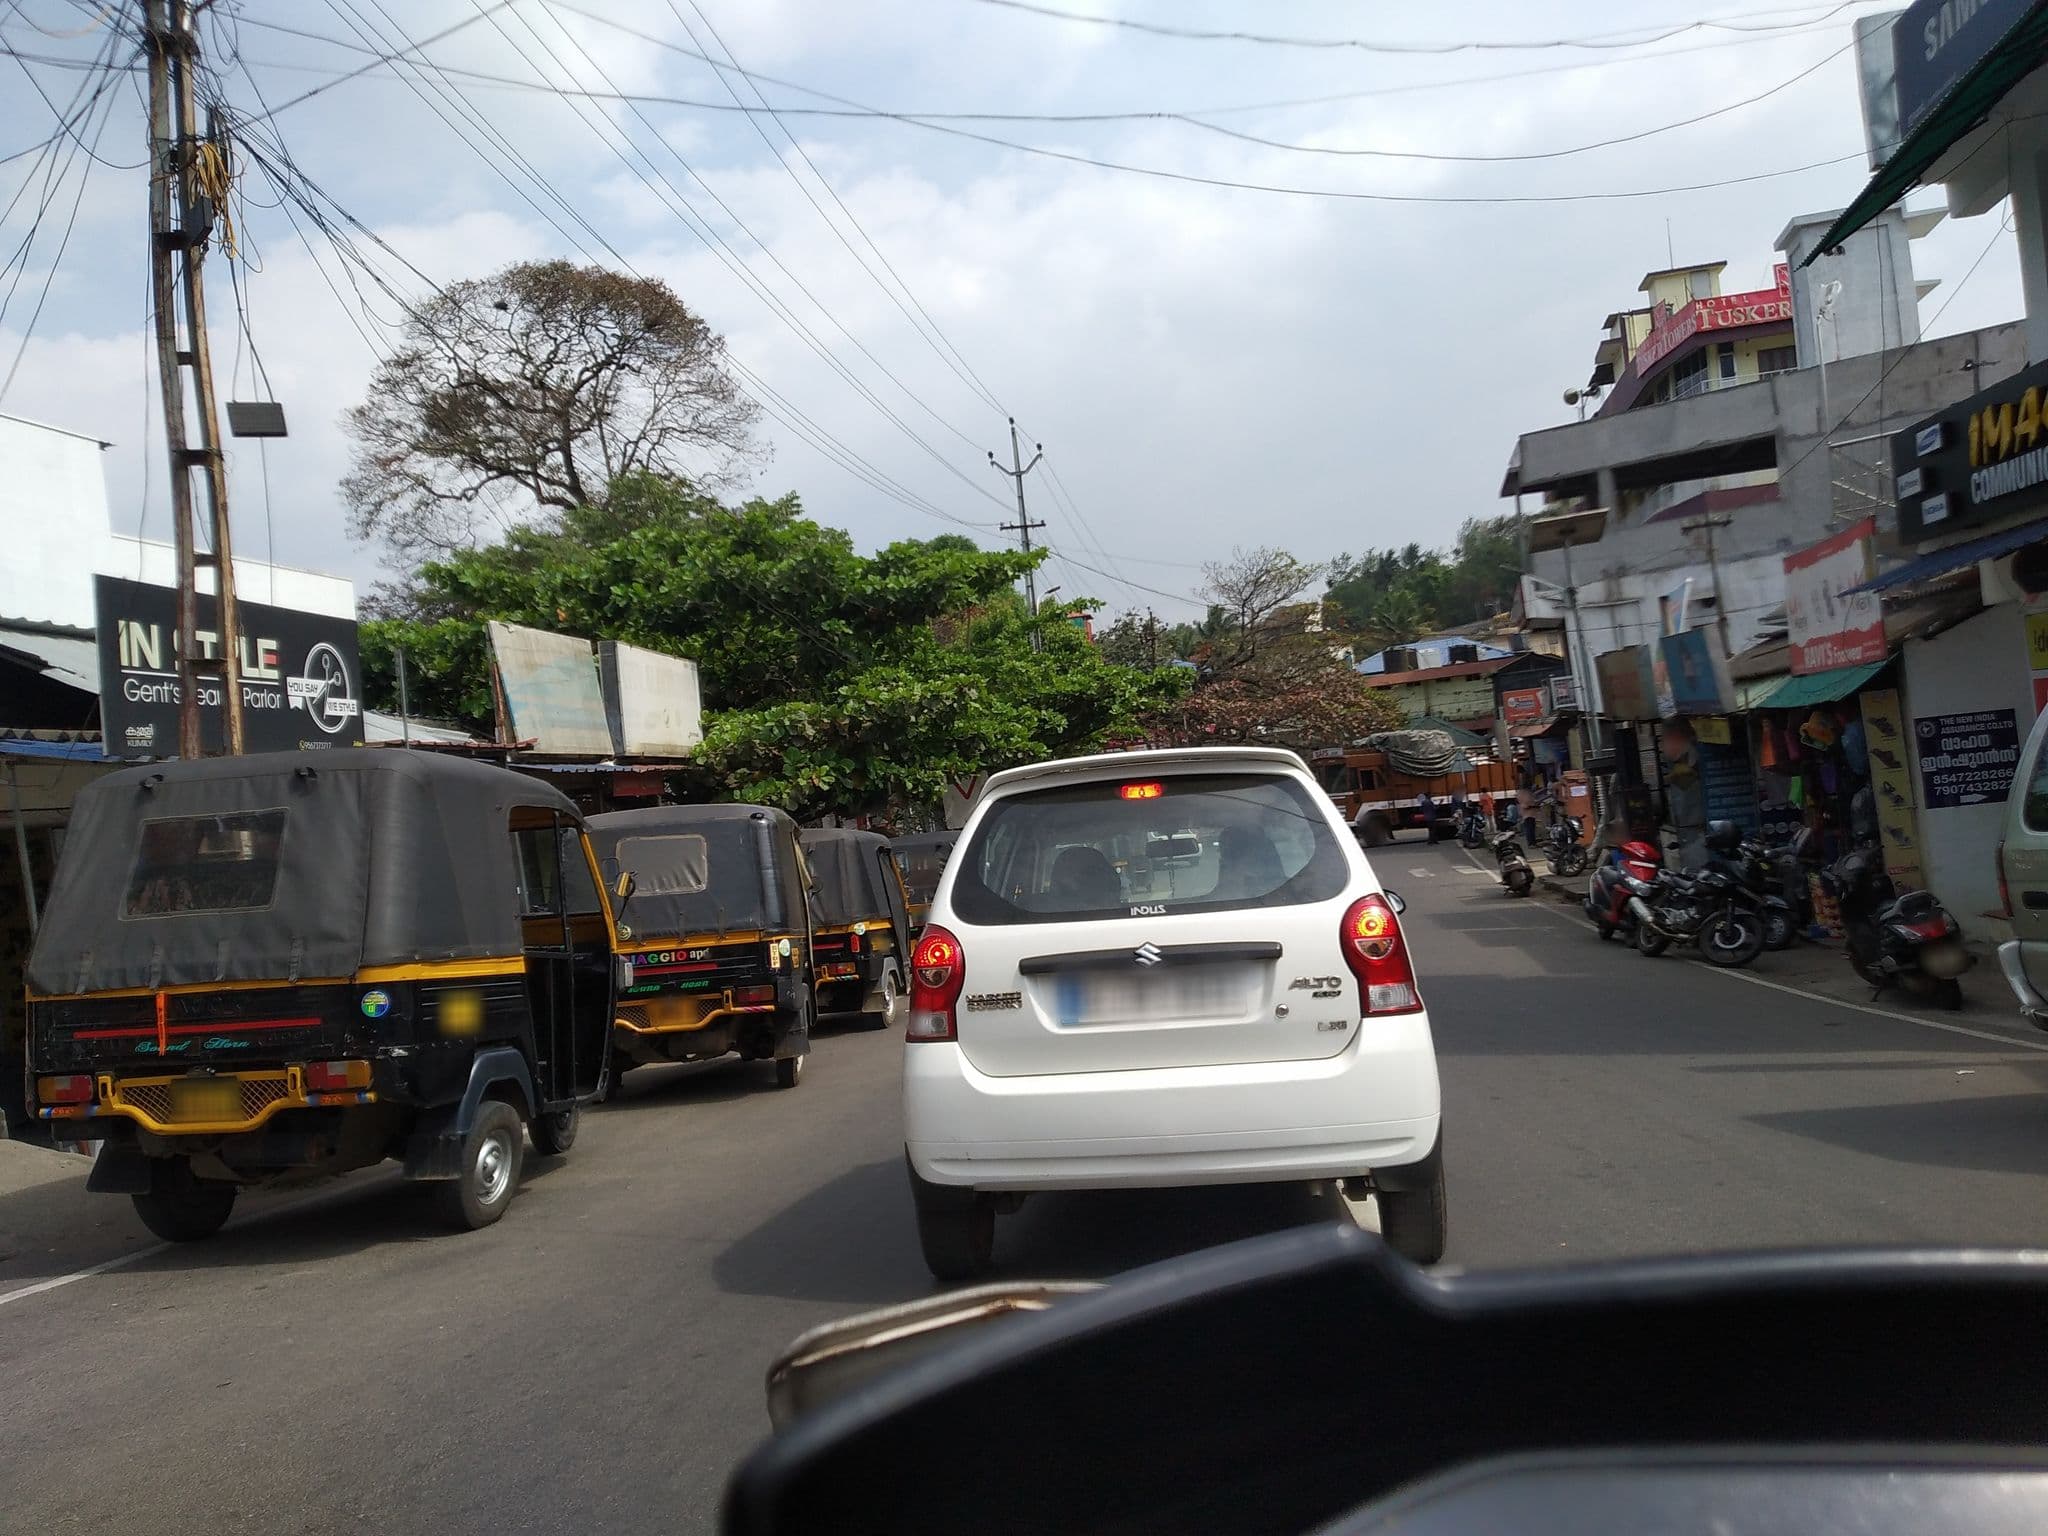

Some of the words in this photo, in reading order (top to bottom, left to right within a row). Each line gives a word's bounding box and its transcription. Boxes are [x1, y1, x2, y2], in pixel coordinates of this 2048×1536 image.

[1924, 0, 1987, 62] SAM
[1695, 294, 1749, 309] HOTEL
[1694, 301, 1793, 330] TUSKER
[1968, 386, 2048, 468] IMA
[118, 619, 161, 669] IN
[173, 628, 280, 680] TLE
[288, 681, 303, 693] YOU
[304, 683, 319, 694] SAY
[242, 686, 281, 710] Parlor
[1939, 717, 1955, 727] THE
[1975, 713, 1996, 723] INDIA
[1940, 723, 1985, 735] ASSURANCE
[1932, 768, 2015, 785] 8547228266
[1130, 904, 1166, 916] INDUS
[625, 950, 687, 965] IAGGIO
[1288, 976, 1342, 990] ALTO
